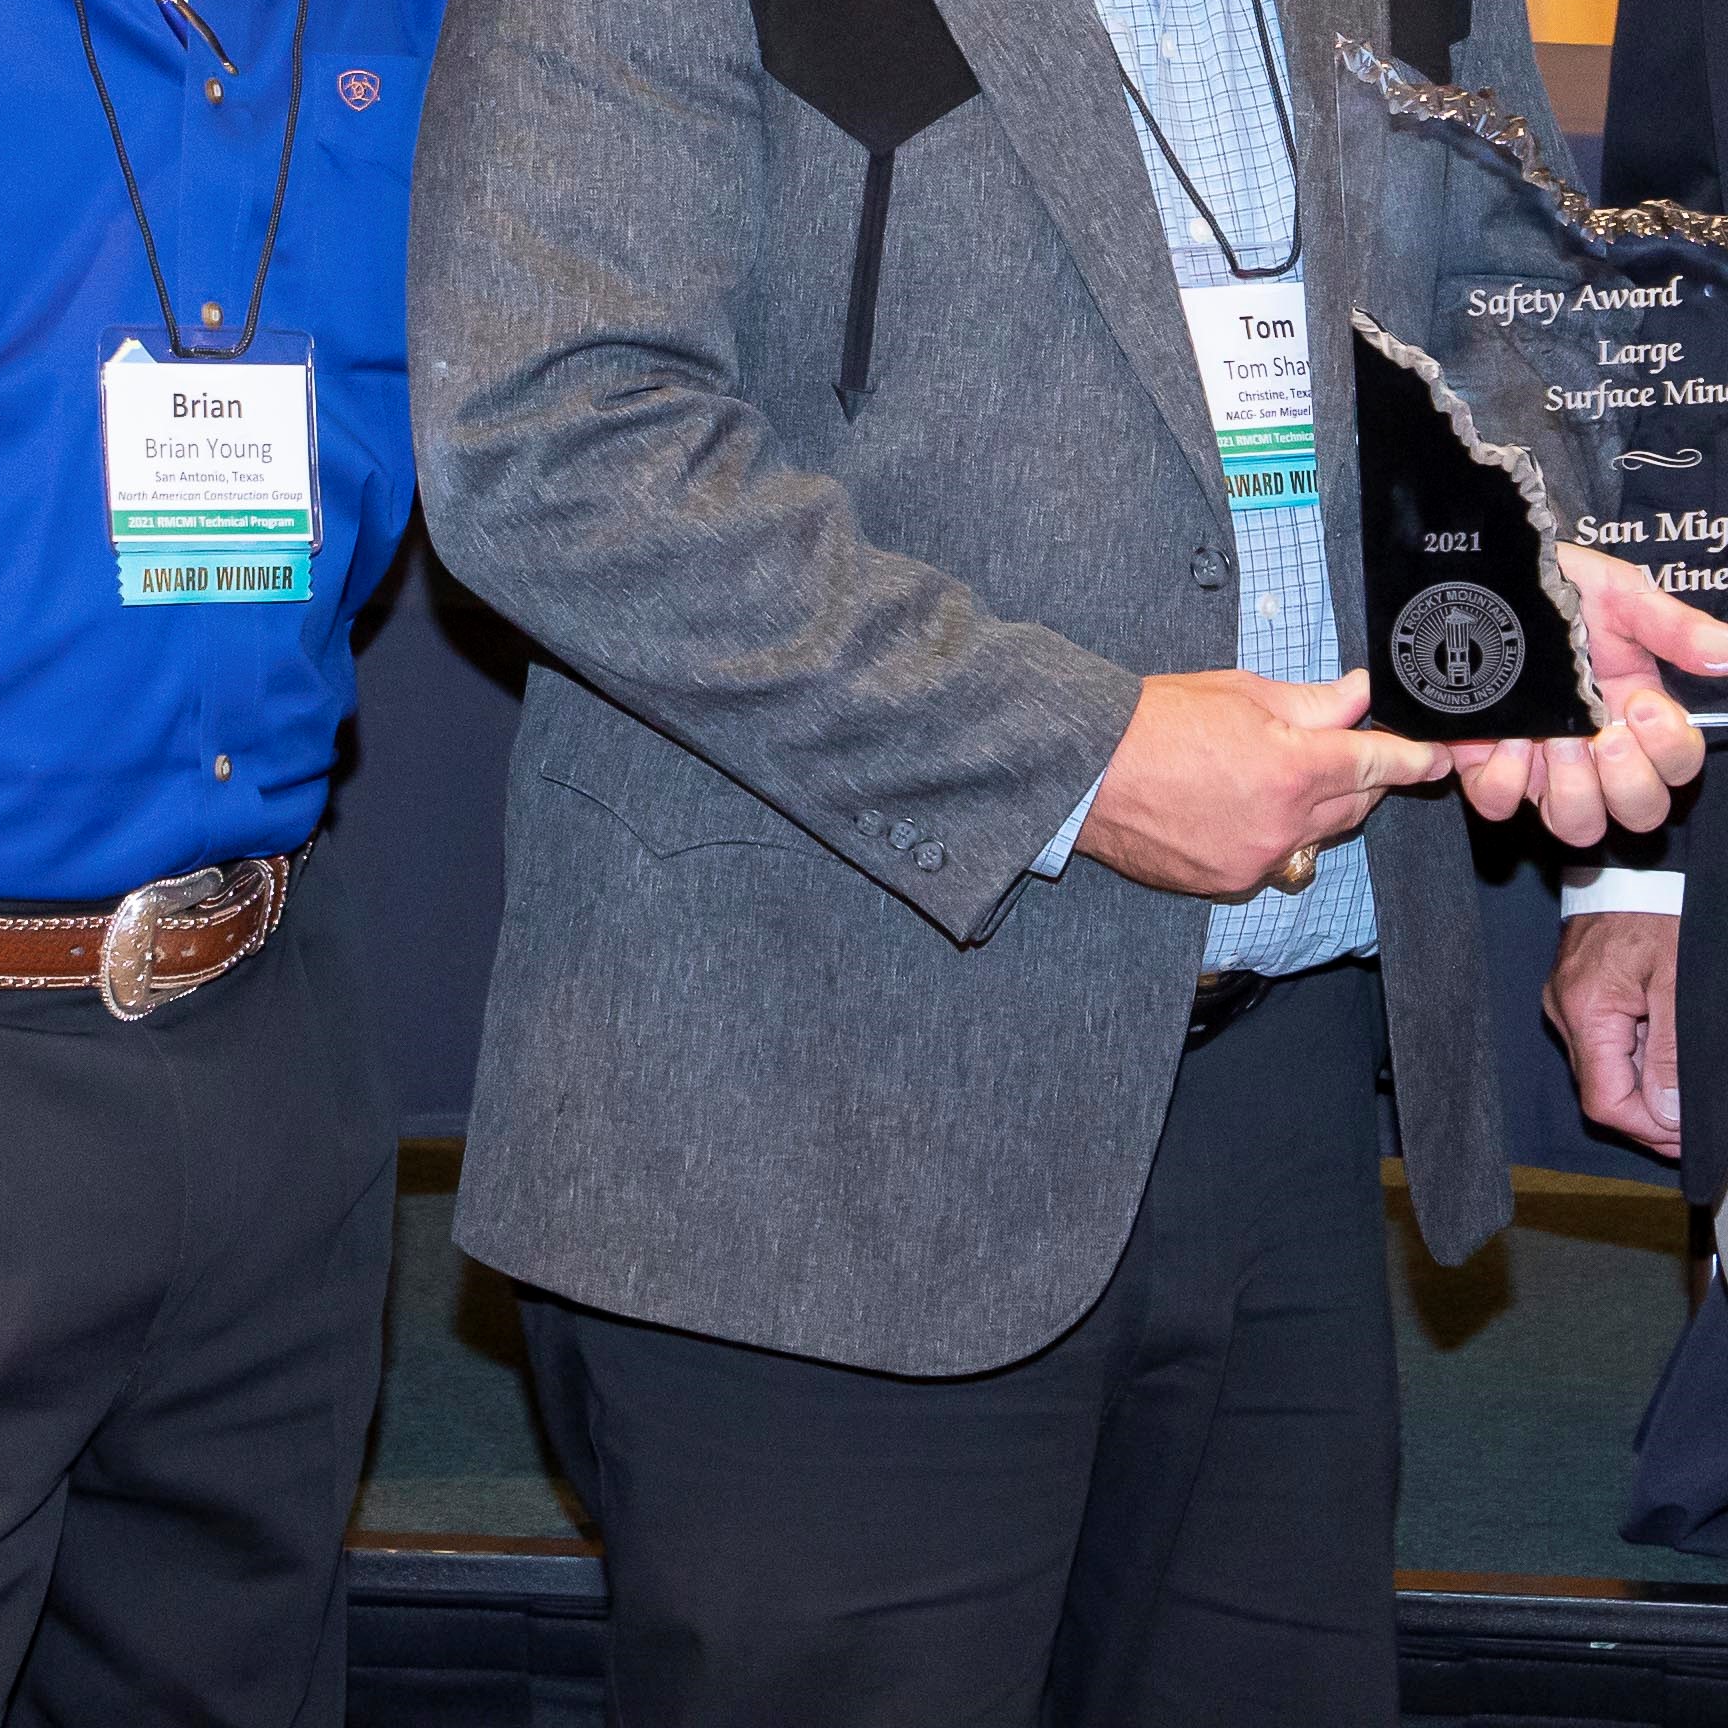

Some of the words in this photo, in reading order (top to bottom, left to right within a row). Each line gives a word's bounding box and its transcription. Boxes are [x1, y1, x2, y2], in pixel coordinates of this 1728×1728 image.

[1467, 283, 1565, 326] Safety
[1571, 275, 1683, 312] Award
[1239, 315, 1295, 340] Tom
[1597, 339, 1684, 374] Large
[1223, 360, 1268, 380] Tom
[172, 392, 243, 418] Brian
[1238, 389, 1289, 402] Christine,
[1544, 379, 1656, 420] Surface
[1260, 409, 1276, 418] San
[1280, 405, 1311, 418] Miguel
[145, 438, 199, 459] Brian
[206, 438, 273, 463] Young
[1237, 433, 1272, 446] RMCMI
[155, 471, 176, 482] San
[180, 471, 229, 484] Antonio,
[232, 471, 264, 482] Texas
[1223, 471, 1284, 498] AWARD
[118, 491, 148, 501] North
[151, 491, 201, 501] American
[204, 491, 268, 501] Construction
[272, 490, 303, 502] Group
[128, 516, 154, 528] 2021
[158, 516, 196, 528] RMCMI
[199, 515, 247, 528] Technical
[250, 515, 294, 530] Program
[1574, 515, 1649, 546] San
[1424, 531, 1482, 552] 2021
[143, 567, 208, 593] AWARD
[216, 565, 293, 591] WINNER
[1403, 590, 1443, 630] ROCKY
[1446, 590, 1510, 627] MOUNTAIN
[1400, 652, 1422, 688] COAL
[1424, 683, 1471, 705] MINING
[1473, 645, 1518, 702] INSTITUTE
